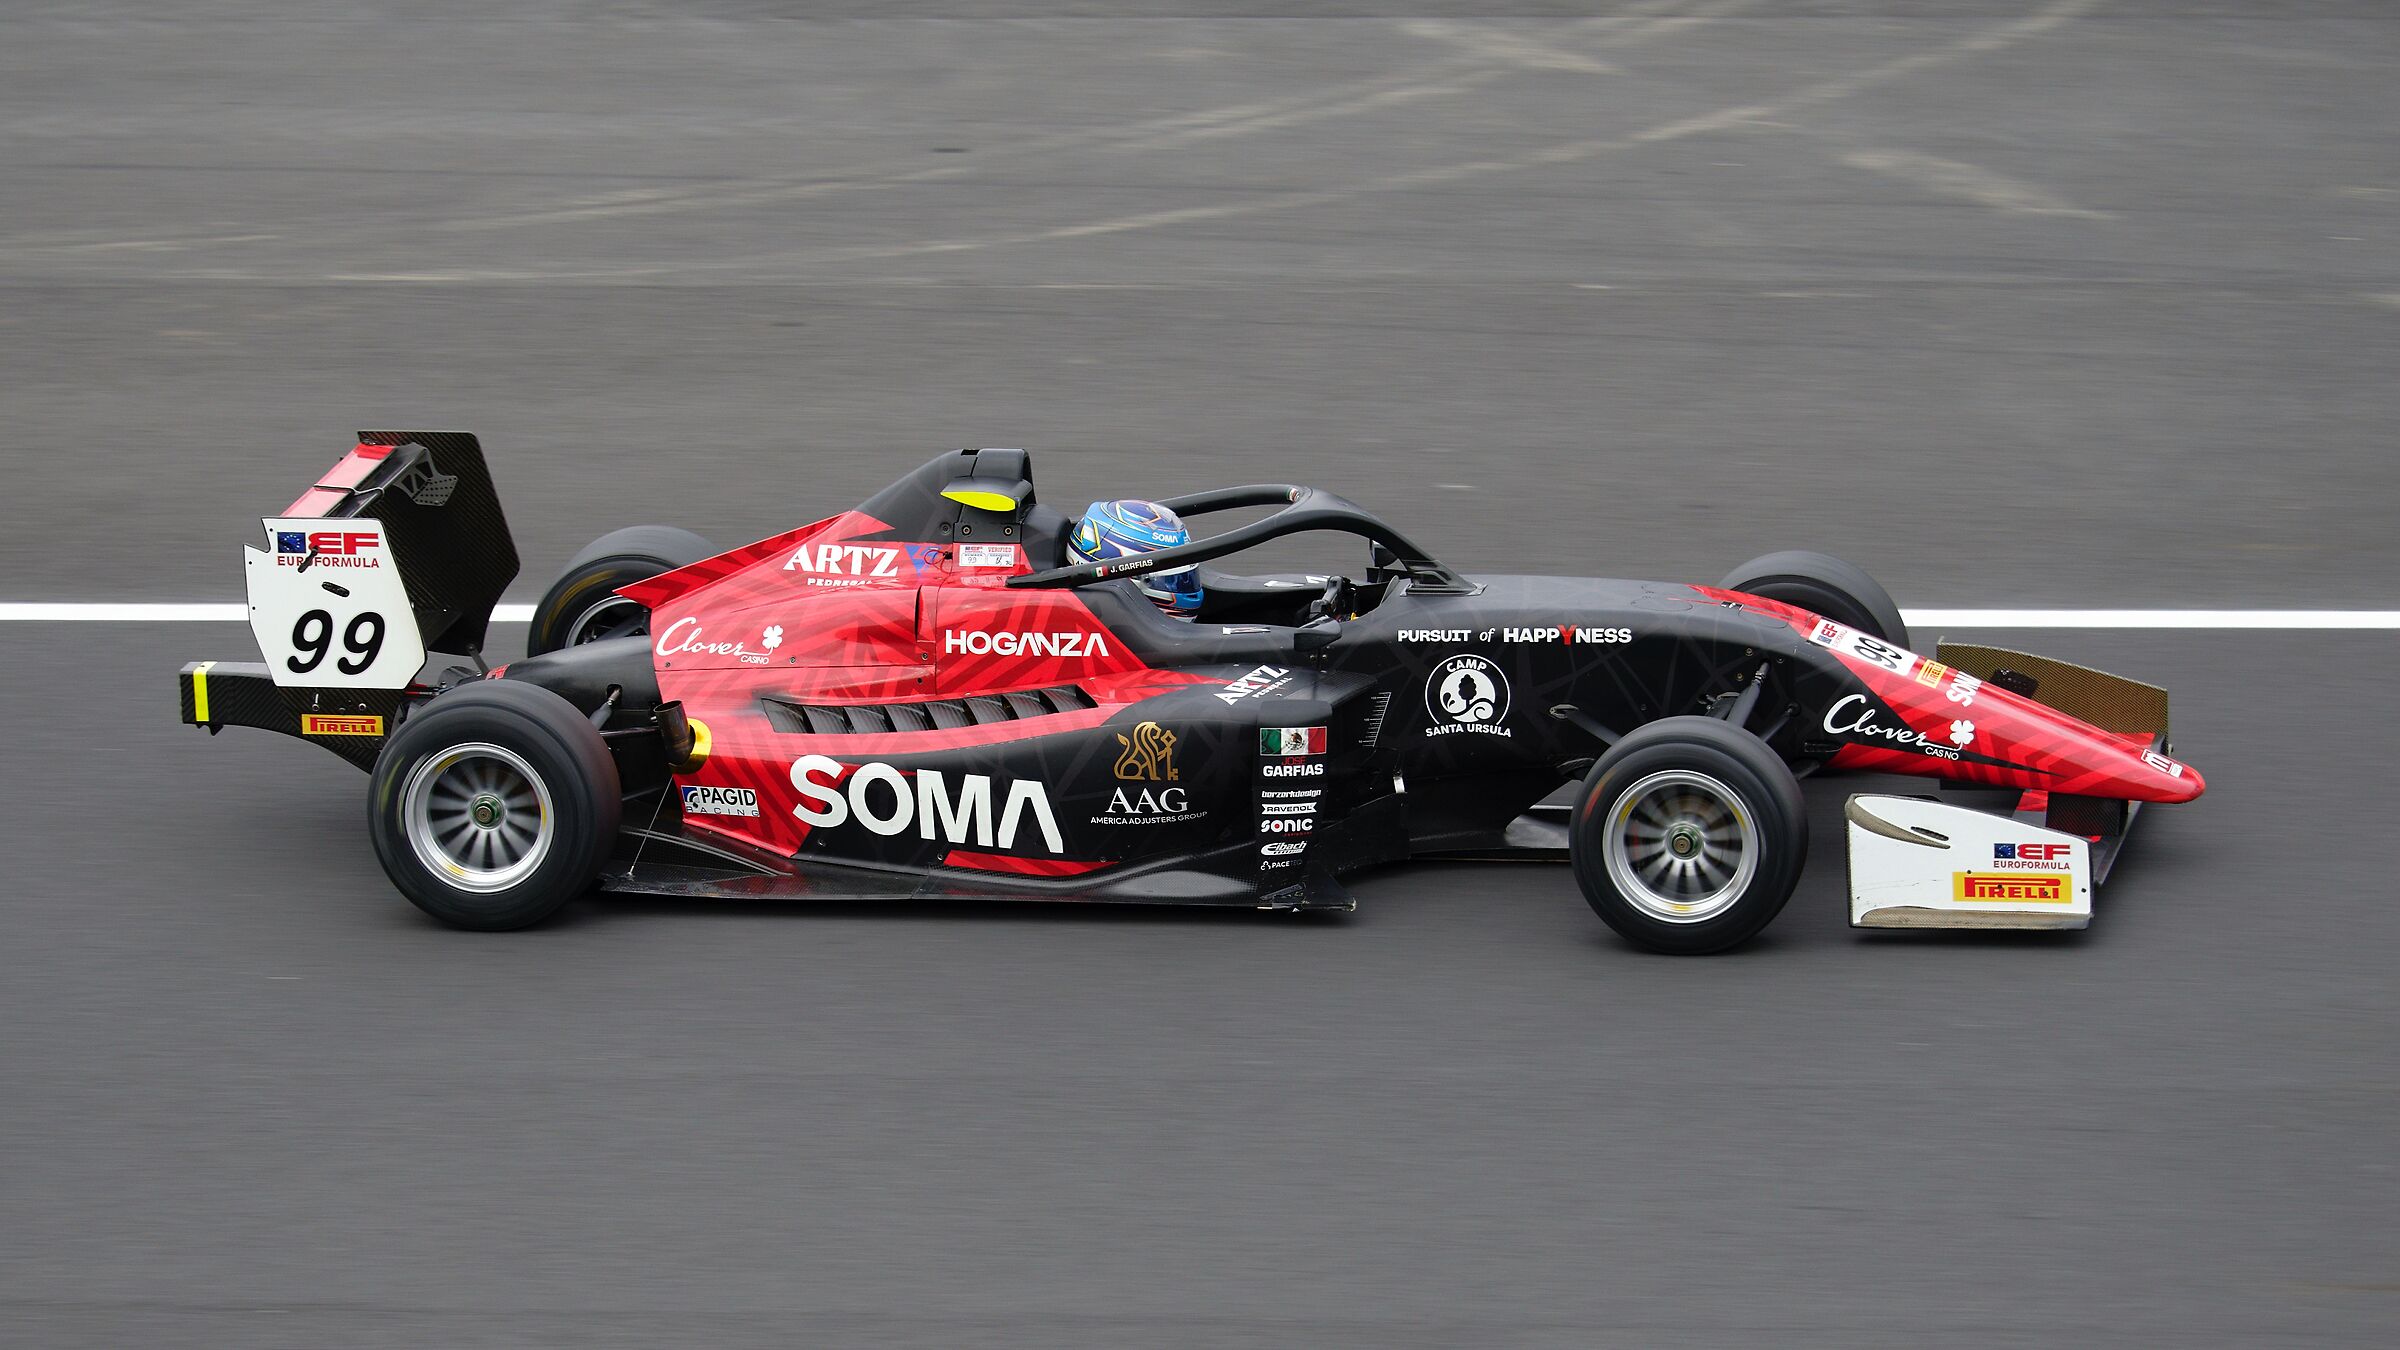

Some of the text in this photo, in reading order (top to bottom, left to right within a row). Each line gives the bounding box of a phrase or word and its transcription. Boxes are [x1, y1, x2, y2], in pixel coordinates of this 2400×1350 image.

[1152, 532, 1179, 543] SOMA
[782, 543, 900, 577] ARTZ
[1110, 559, 1154, 574] J. GARFIAS
[287, 609, 386, 676] 99
[656, 616, 750, 657] Clover
[945, 629, 1110, 657] HOGANZA
[1398, 624, 1632, 646] PURSUIT of HAPPYNESS
[740, 655, 770, 665] CASINO
[1854, 637, 1902, 670] 99
[1446, 658, 1488, 672] CAMP
[1213, 664, 1290, 706] ARTZ
[309, 717, 376, 734] PIRELLI
[1823, 693, 1928, 747] Clover
[1425, 723, 1512, 738] SANTA URSULA
[1263, 764, 1324, 777] GARFIAS
[700, 787, 756, 806] PAGID
[790, 754, 1064, 854] SOMA
[1105, 786, 1189, 814] AAG
[686, 806, 760, 816] RACING
[1266, 805, 1313, 813] RAVENOL
[1090, 811, 1208, 825] AMERICA ADJUSTERS GROUP
[1261, 841, 1307, 855] Eibach
[2017, 844, 2071, 860] EF
[1993, 861, 2070, 870] EUROFORMULA
[1964, 876, 2061, 899] PIRELLI
